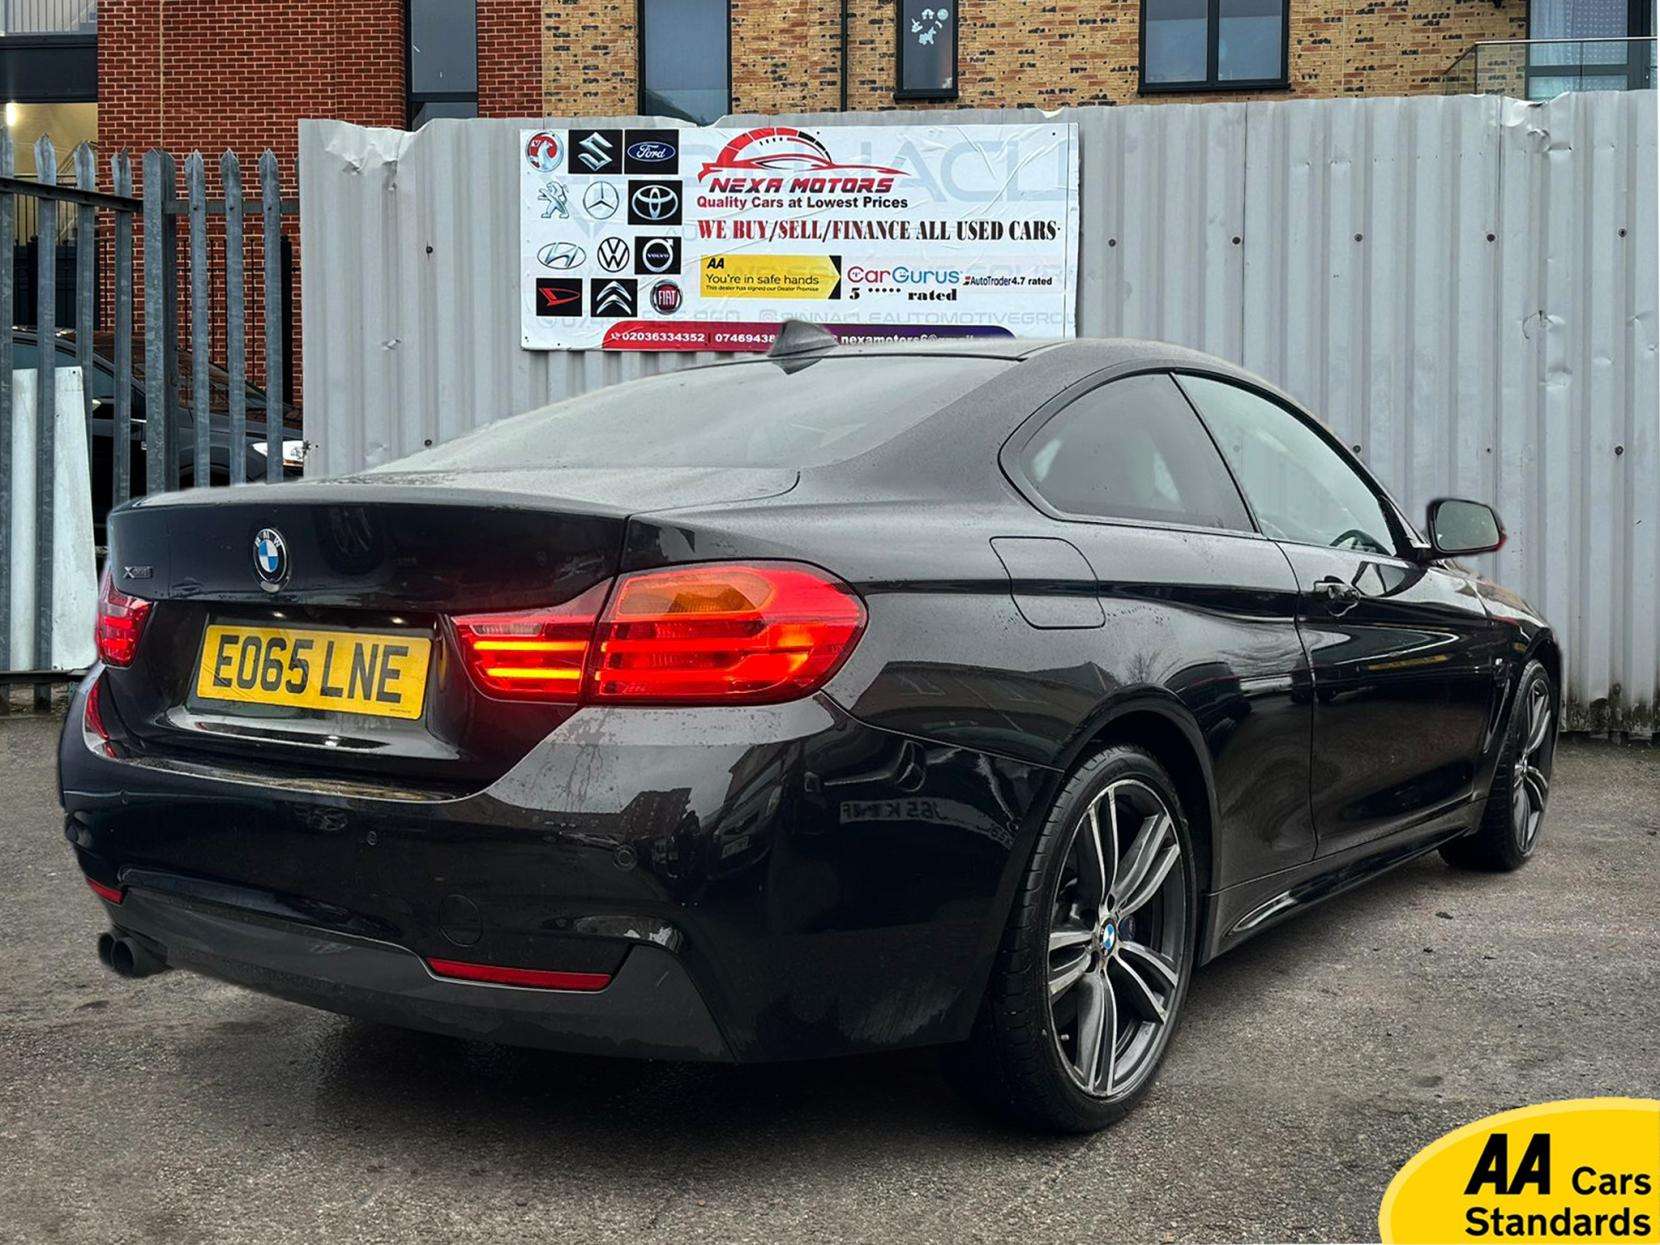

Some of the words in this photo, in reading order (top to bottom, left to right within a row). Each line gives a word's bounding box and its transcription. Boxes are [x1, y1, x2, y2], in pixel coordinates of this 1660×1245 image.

[636, 144, 667, 159] Ford
[708, 177, 783, 193] NEXA
[789, 177, 894, 193] MOTORS
[697, 196, 747, 210] Quality
[751, 196, 783, 208] Cars
[788, 197, 802, 208] at
[807, 196, 858, 208] Lowest
[863, 196, 908, 208] Prices
[697, 220, 726, 240] WE
[916, 220, 950, 240] ALL
[956, 220, 1003, 241] USED
[1008, 220, 1057, 241] CARS
[706, 257, 725, 269] AA
[706, 273, 740, 284] You're
[744, 274, 754, 284] in
[757, 273, 781, 284] safe
[783, 274, 820, 285] hands
[847, 266, 961, 284] CarGurus
[1028, 276, 1053, 286] rated
[658, 291, 676, 307] FIAT
[849, 287, 860, 301] 5
[908, 288, 958, 301] rated
[622, 333, 705, 343] 02036334352
[320, 640, 409, 704] LNE
